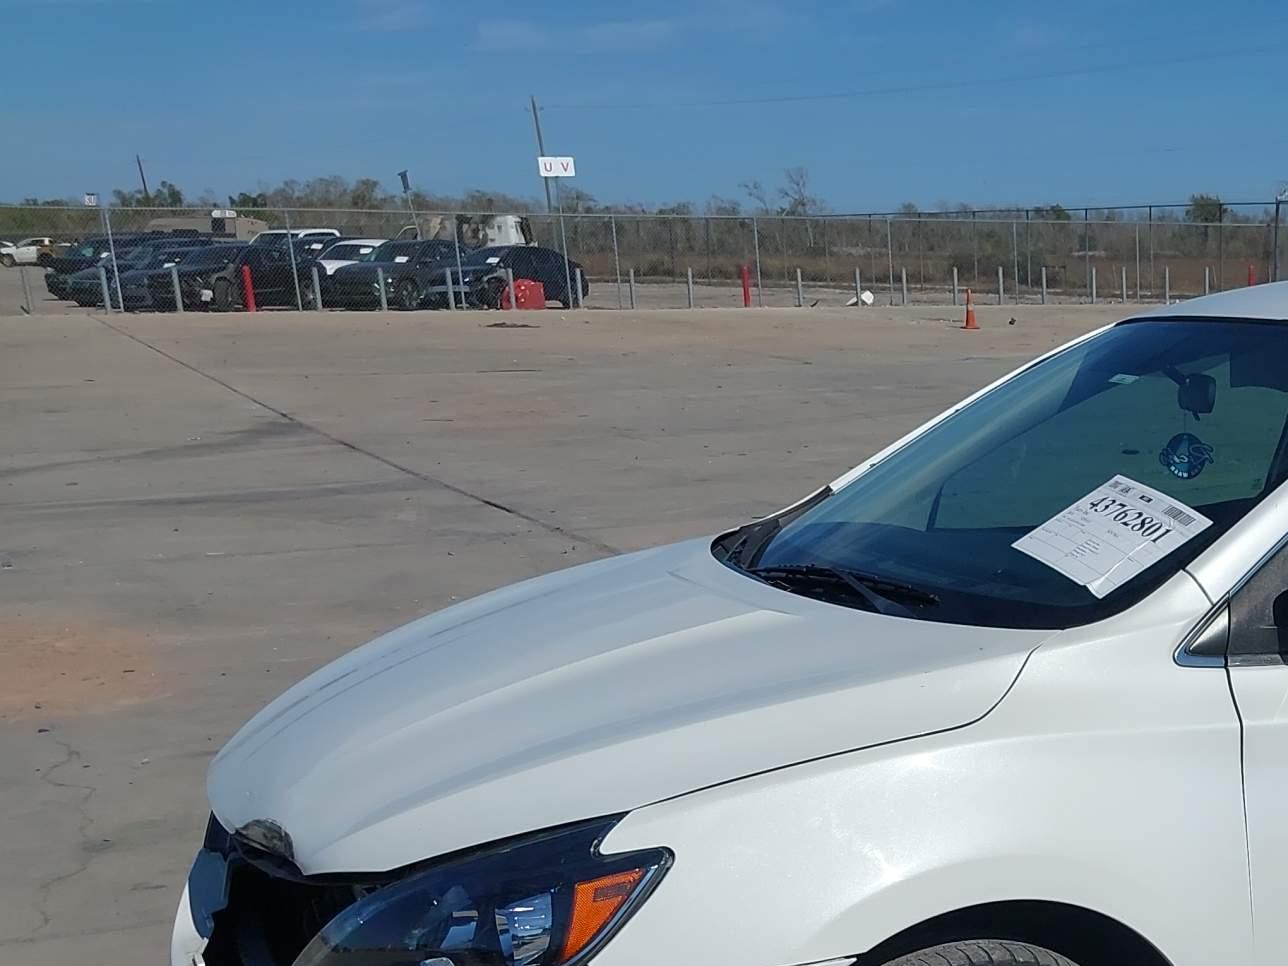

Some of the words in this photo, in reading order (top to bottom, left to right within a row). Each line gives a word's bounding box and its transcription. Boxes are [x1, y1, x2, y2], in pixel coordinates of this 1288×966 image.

[544, 162, 553, 172] U
[561, 162, 569, 172] V
[1089, 496, 1173, 543] 43762801
